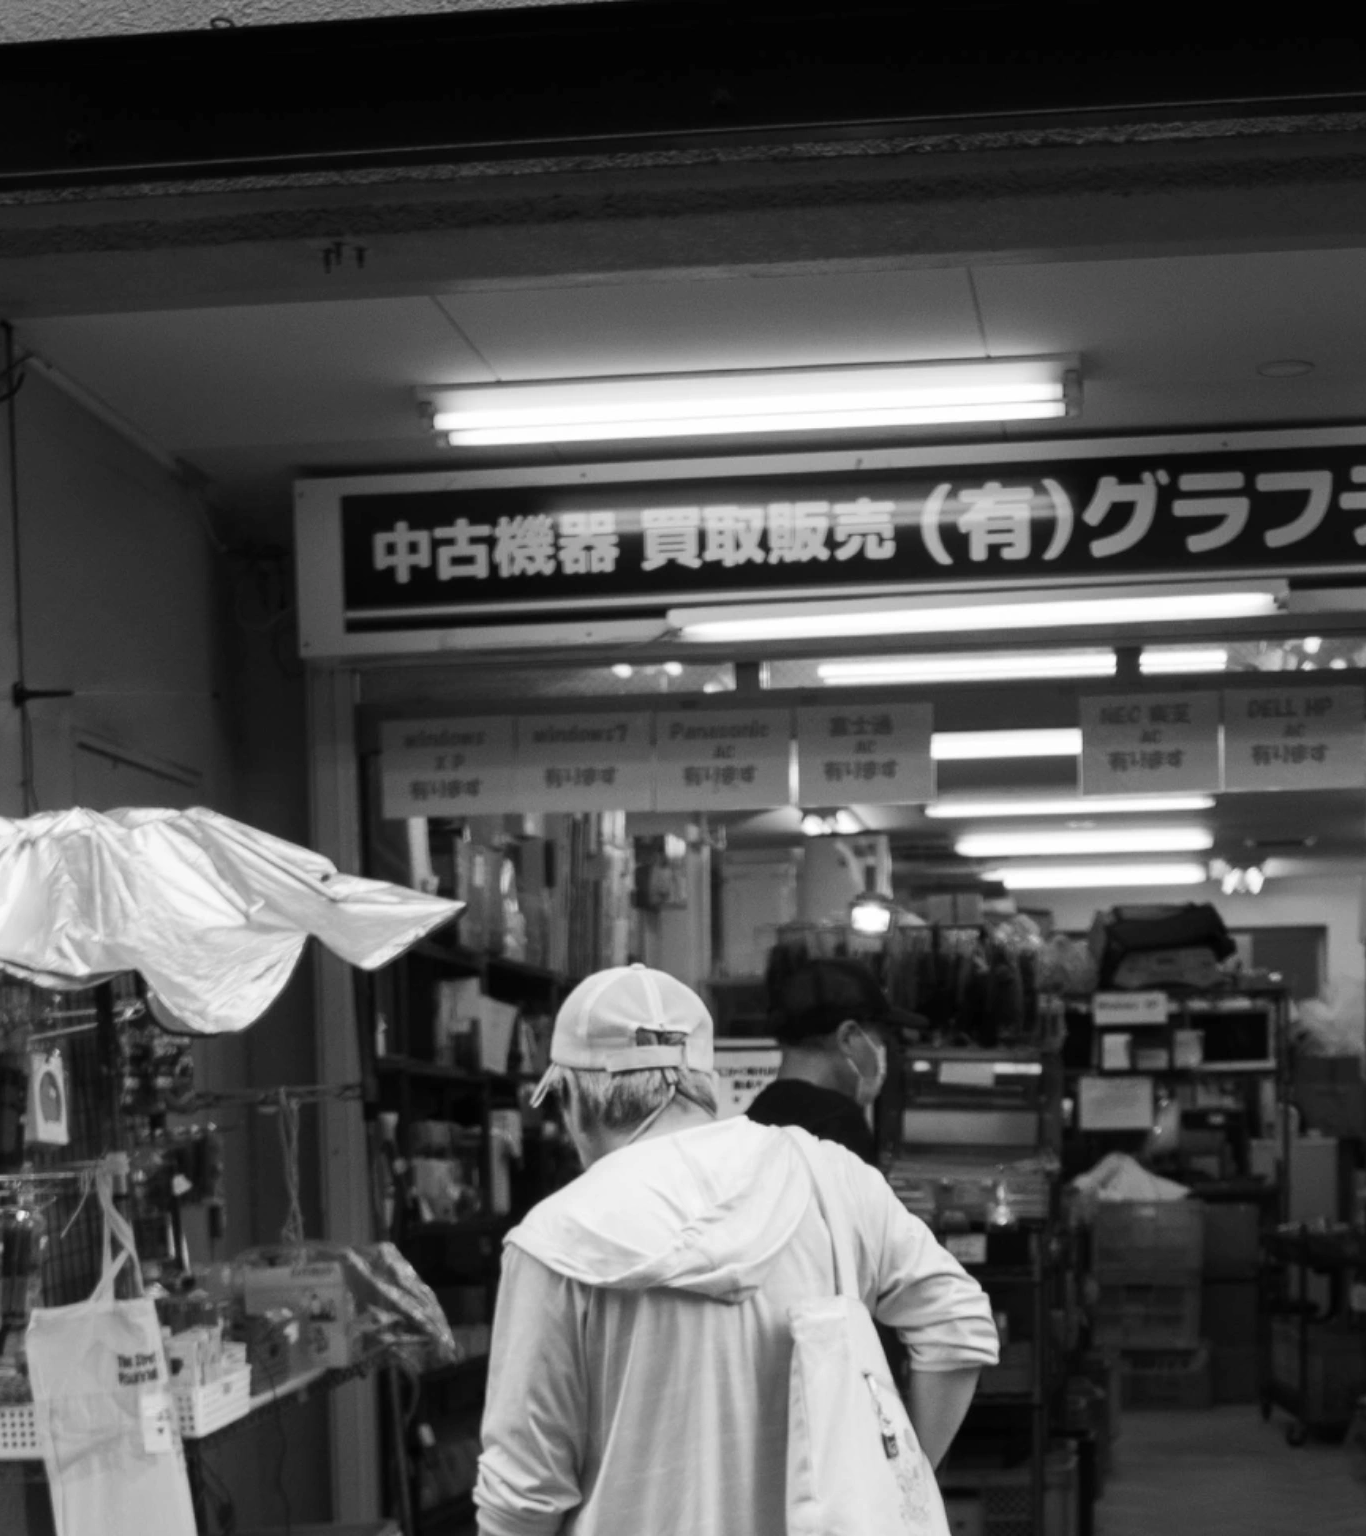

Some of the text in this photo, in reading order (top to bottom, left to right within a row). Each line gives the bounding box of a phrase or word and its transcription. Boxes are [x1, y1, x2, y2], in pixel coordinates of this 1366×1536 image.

[373, 512, 620, 583] 中古機器
[640, 497, 897, 571] 買取販売
[1248, 697, 1297, 719] DELL
[669, 720, 769, 740] Panasonic
